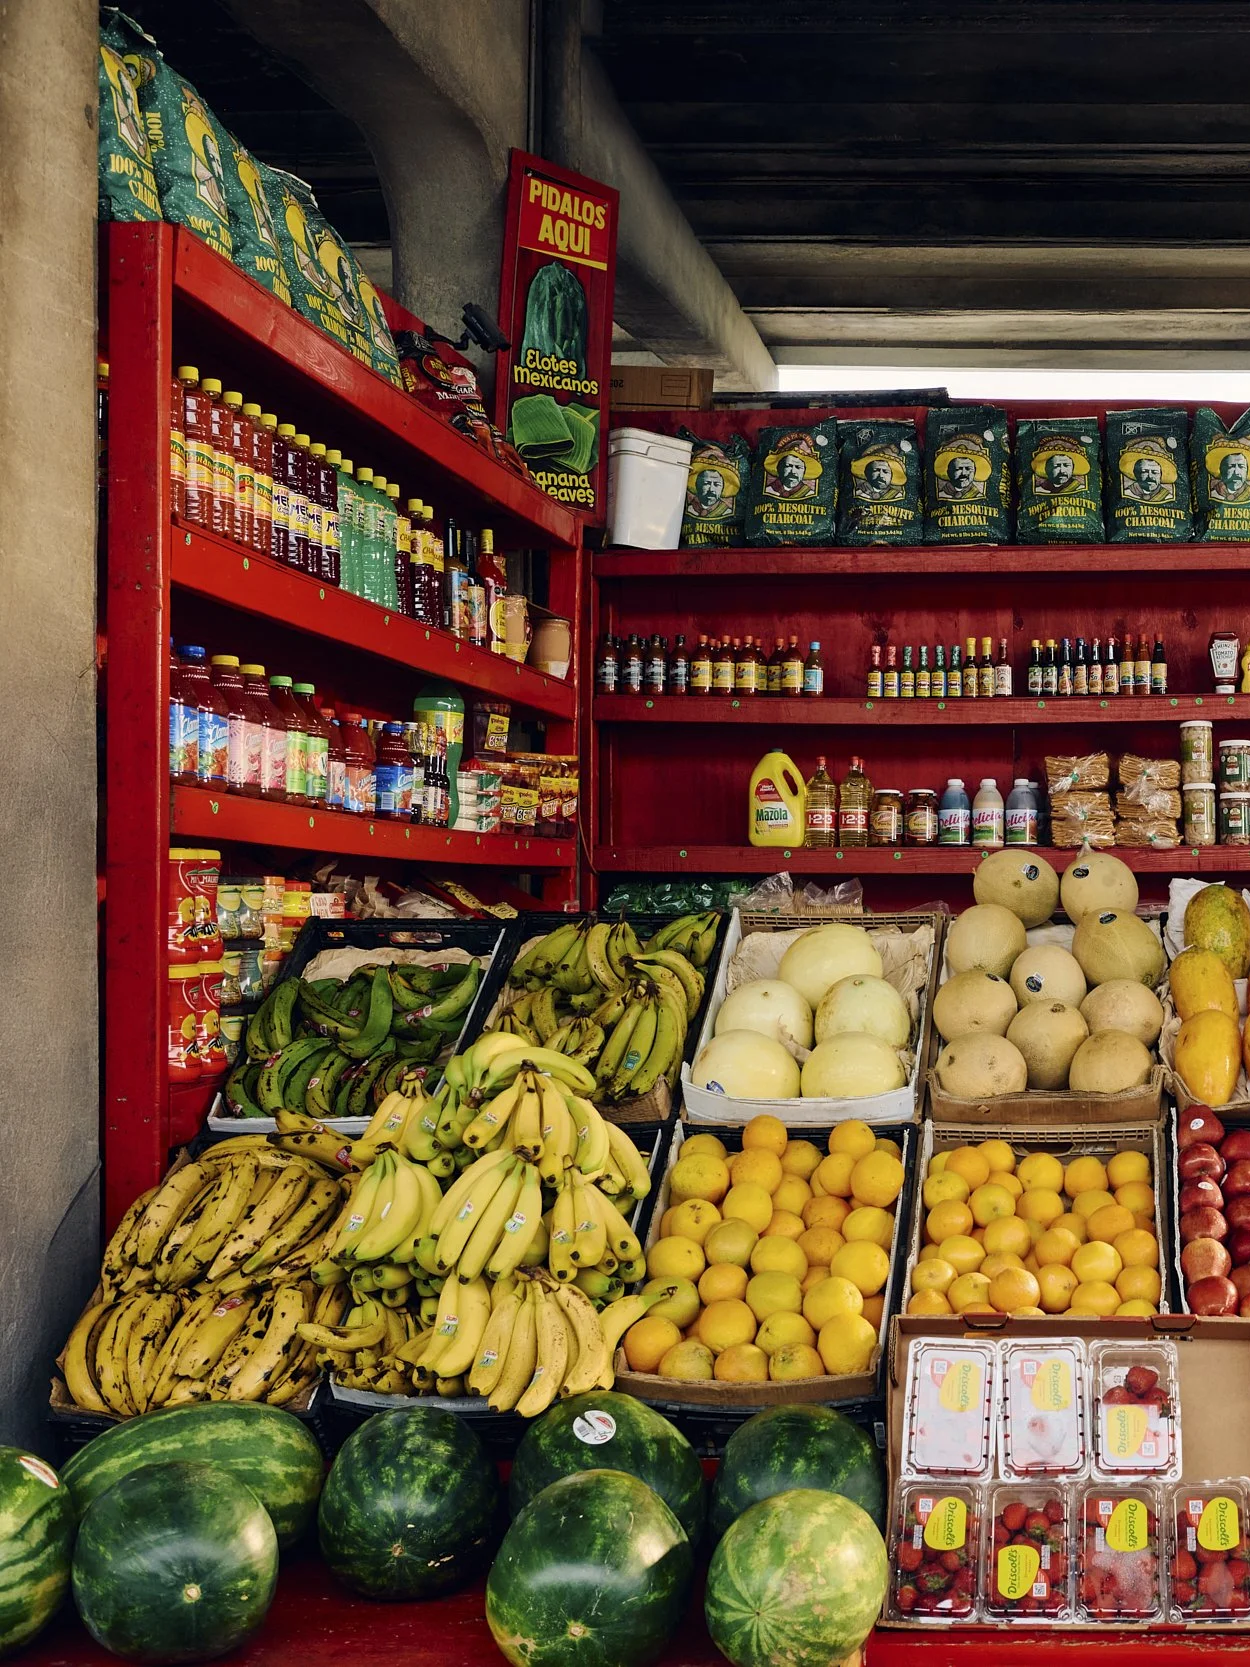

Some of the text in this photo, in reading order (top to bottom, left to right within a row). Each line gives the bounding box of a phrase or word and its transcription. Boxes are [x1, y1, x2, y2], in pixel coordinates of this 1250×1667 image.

[110, 153, 143, 178] 100%
[528, 179, 607, 230] PIDALOS
[538, 214, 591, 256] AQUI
[525, 349, 577, 375] Elotes
[754, 502, 775, 515] 100%
[777, 503, 827, 516] MESQUITE
[951, 504, 999, 518] MESQUITE
[1028, 496, 1097, 518] 100% MESQUITE
[1114, 505, 1186, 520] 100% MESQUITE
[762, 514, 814, 525] CHARCOAL
[938, 515, 989, 527] CHARCOAL
[1125, 517, 1176, 529] CHARCOAL
[756, 809, 788, 821] Mazola
[945, 1500, 958, 1547] Driscoll's
[1128, 1502, 1138, 1549] Driscoll's
[1217, 1501, 1228, 1547] Driscoll's
[1007, 1548, 1018, 1595] Driscoll's
